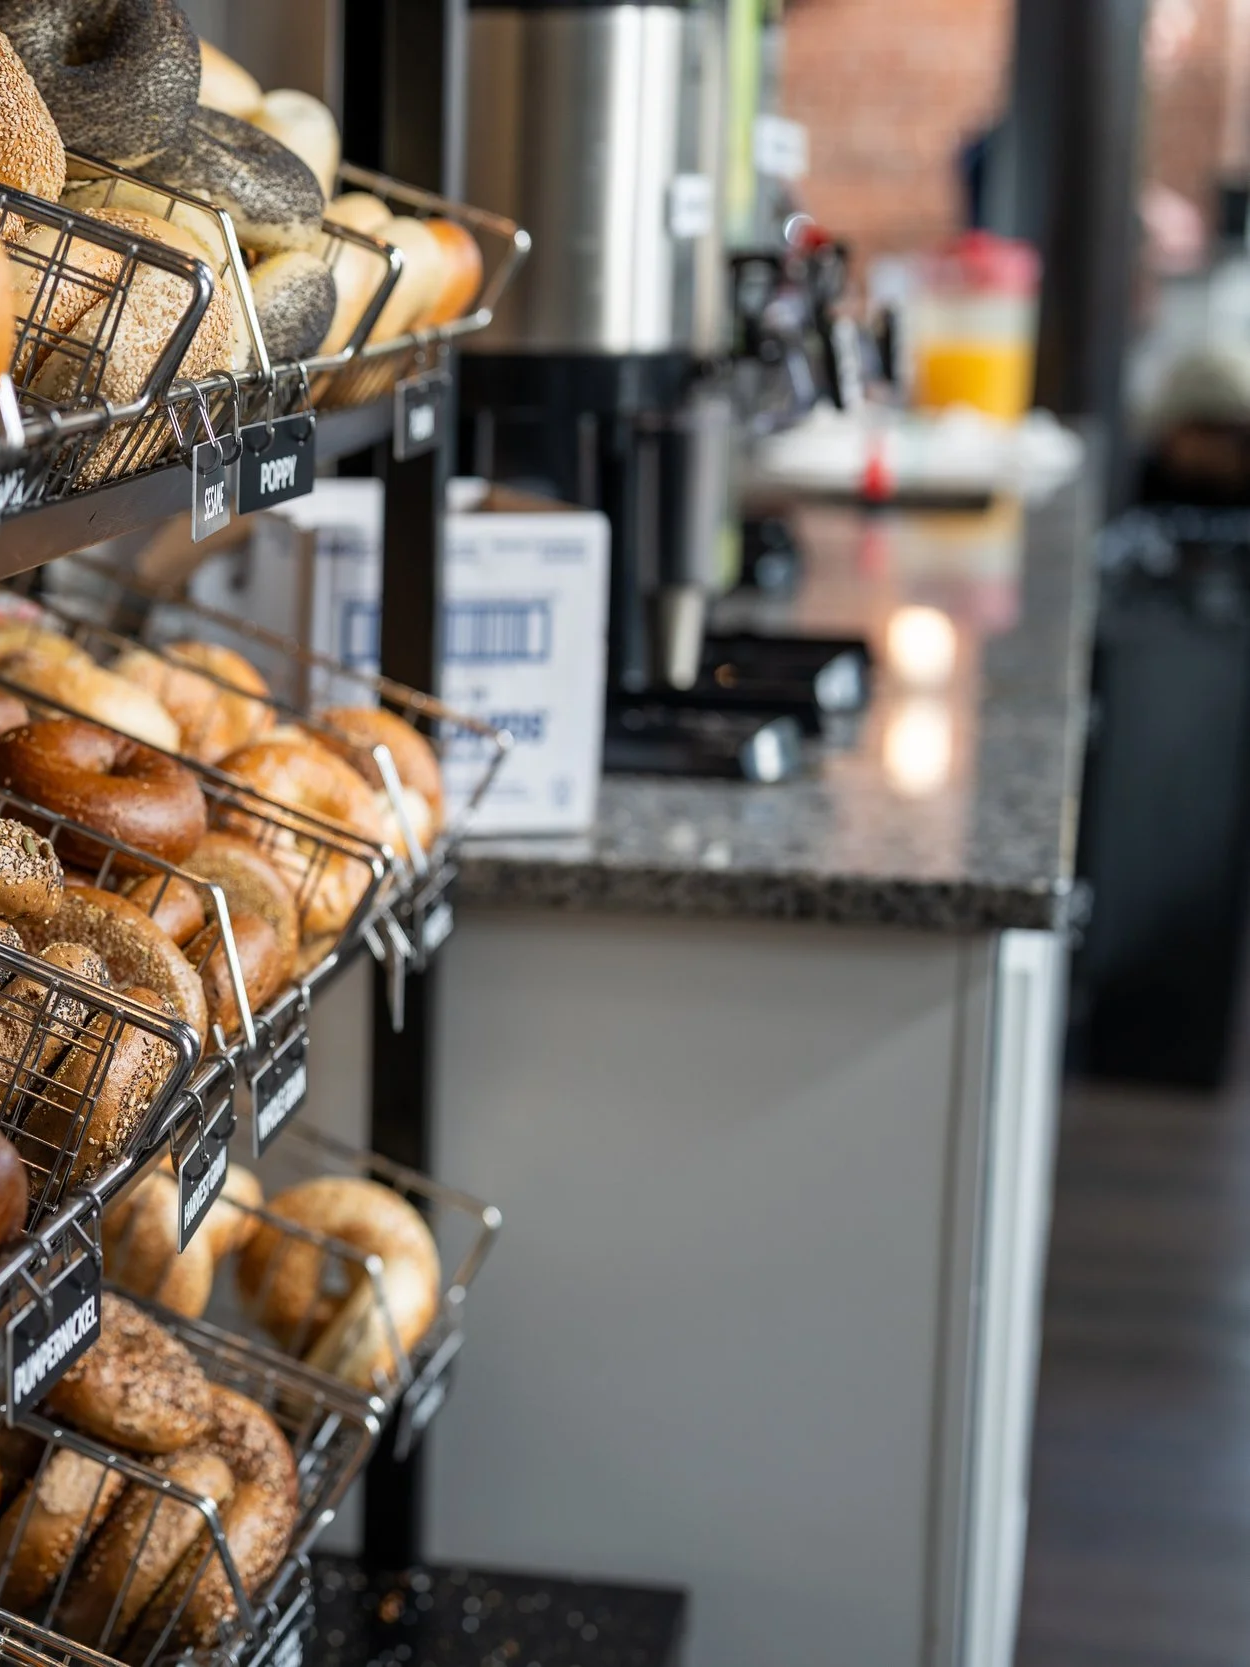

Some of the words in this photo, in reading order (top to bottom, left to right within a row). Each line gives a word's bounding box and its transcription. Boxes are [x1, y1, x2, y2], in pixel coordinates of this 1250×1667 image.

[261, 454, 297, 494] POPPY
[205, 481, 224, 521] SESAME
[184, 1169, 210, 1230] HARVEST
[14, 1295, 98, 1404] PUMPERNICKEL
